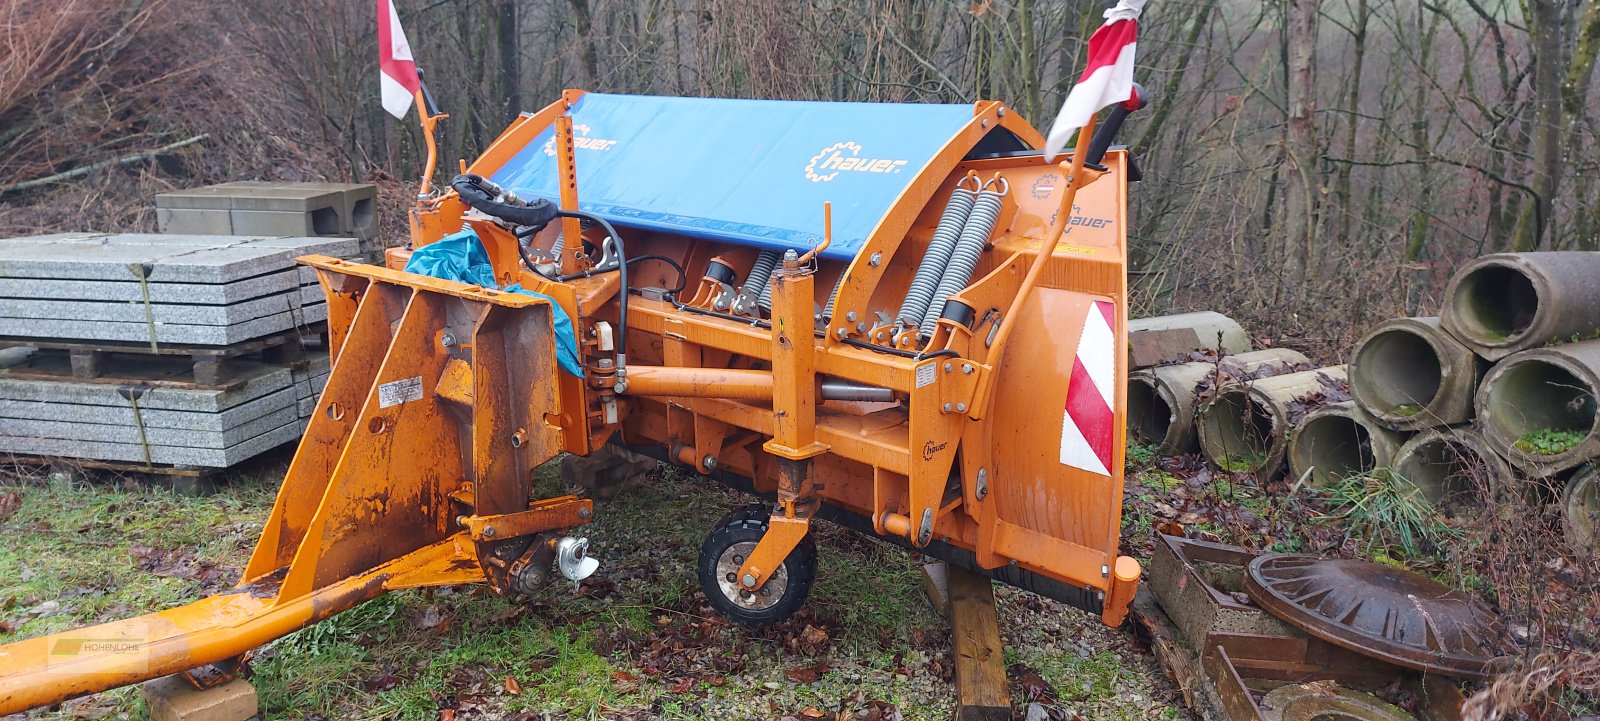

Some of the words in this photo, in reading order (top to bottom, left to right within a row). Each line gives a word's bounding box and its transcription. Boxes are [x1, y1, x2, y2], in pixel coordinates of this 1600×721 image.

[573, 137, 617, 150] auer
[819, 151, 908, 172] hauer
[927, 442, 948, 455] hauer
